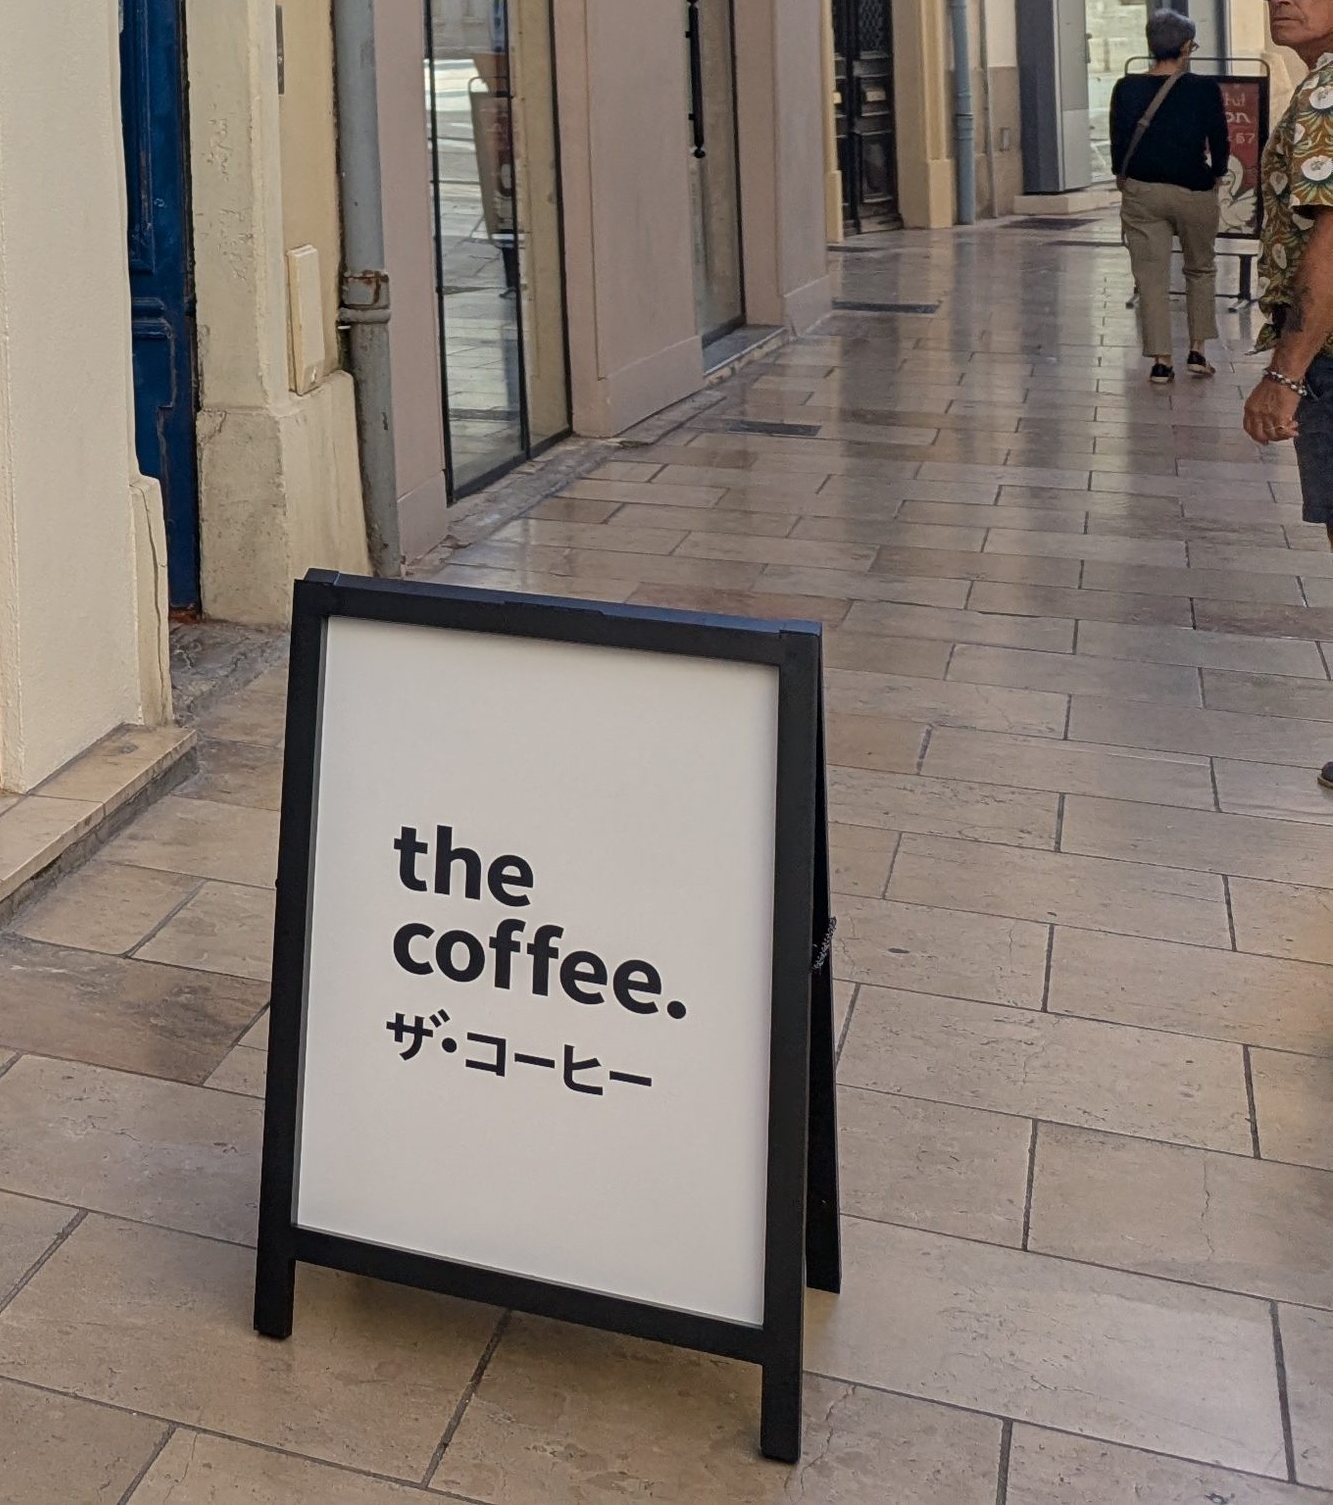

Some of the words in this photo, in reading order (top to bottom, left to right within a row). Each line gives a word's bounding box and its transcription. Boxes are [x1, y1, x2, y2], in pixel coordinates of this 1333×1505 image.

[393, 824, 534, 907] the
[393, 918, 687, 1020] coffee.
[386, 1009, 652, 1096] ザ・コーヒー
